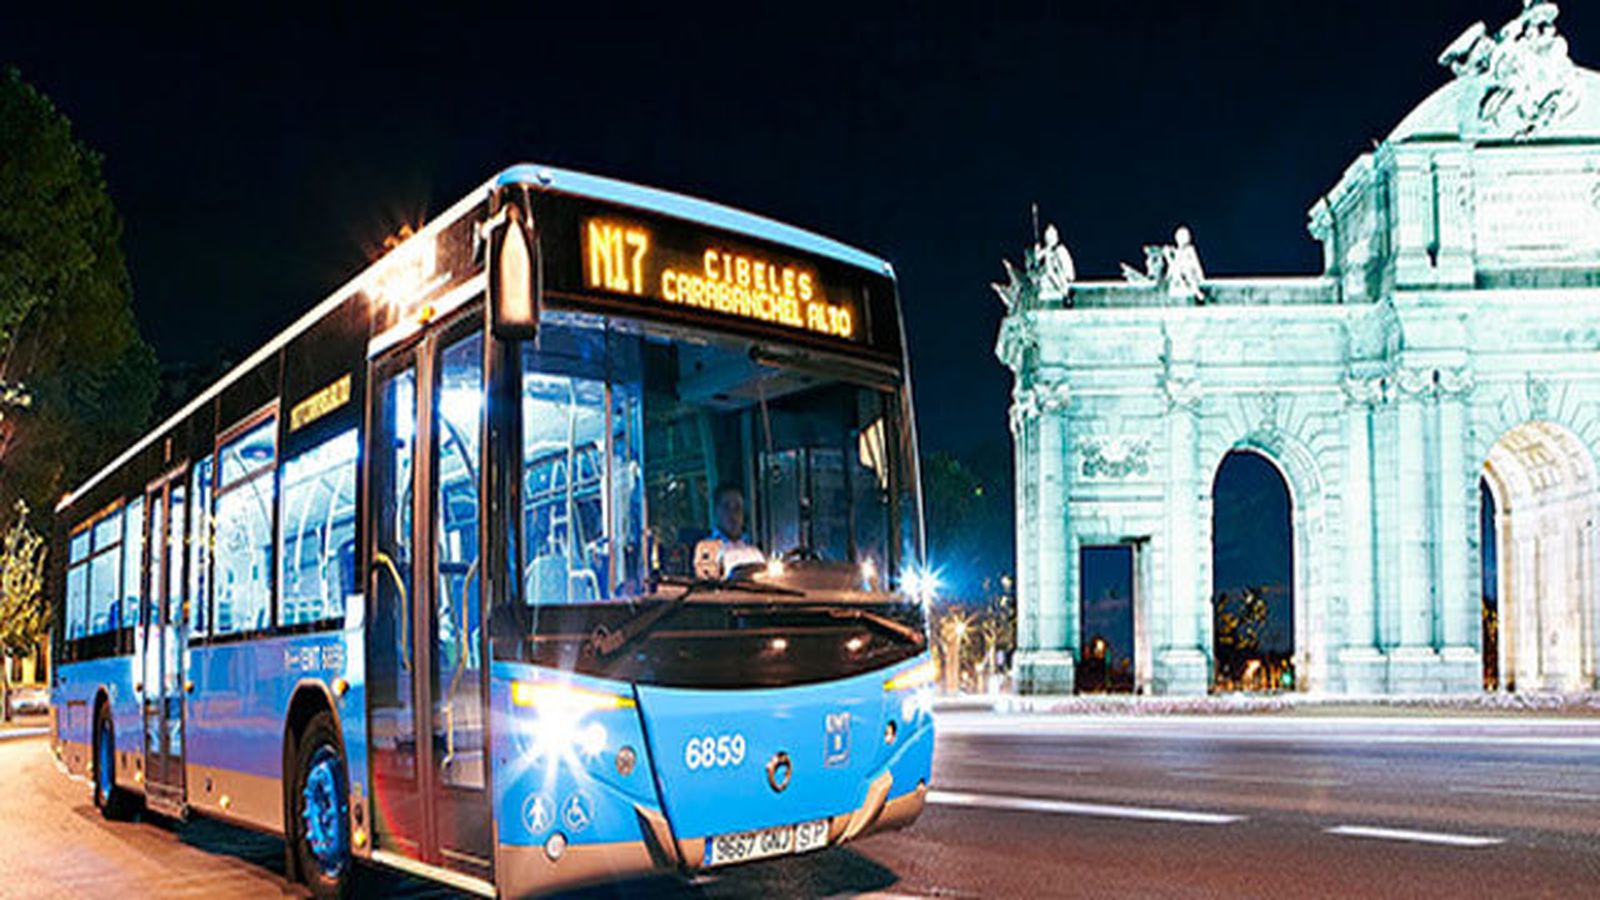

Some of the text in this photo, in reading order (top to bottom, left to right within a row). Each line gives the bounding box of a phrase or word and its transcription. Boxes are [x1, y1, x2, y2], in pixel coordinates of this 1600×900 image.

[588, 220, 648, 294] N17
[704, 249, 812, 301] CIBELES
[662, 268, 852, 338] CARABANCHEL ALTO
[685, 733, 746, 770] 6859
